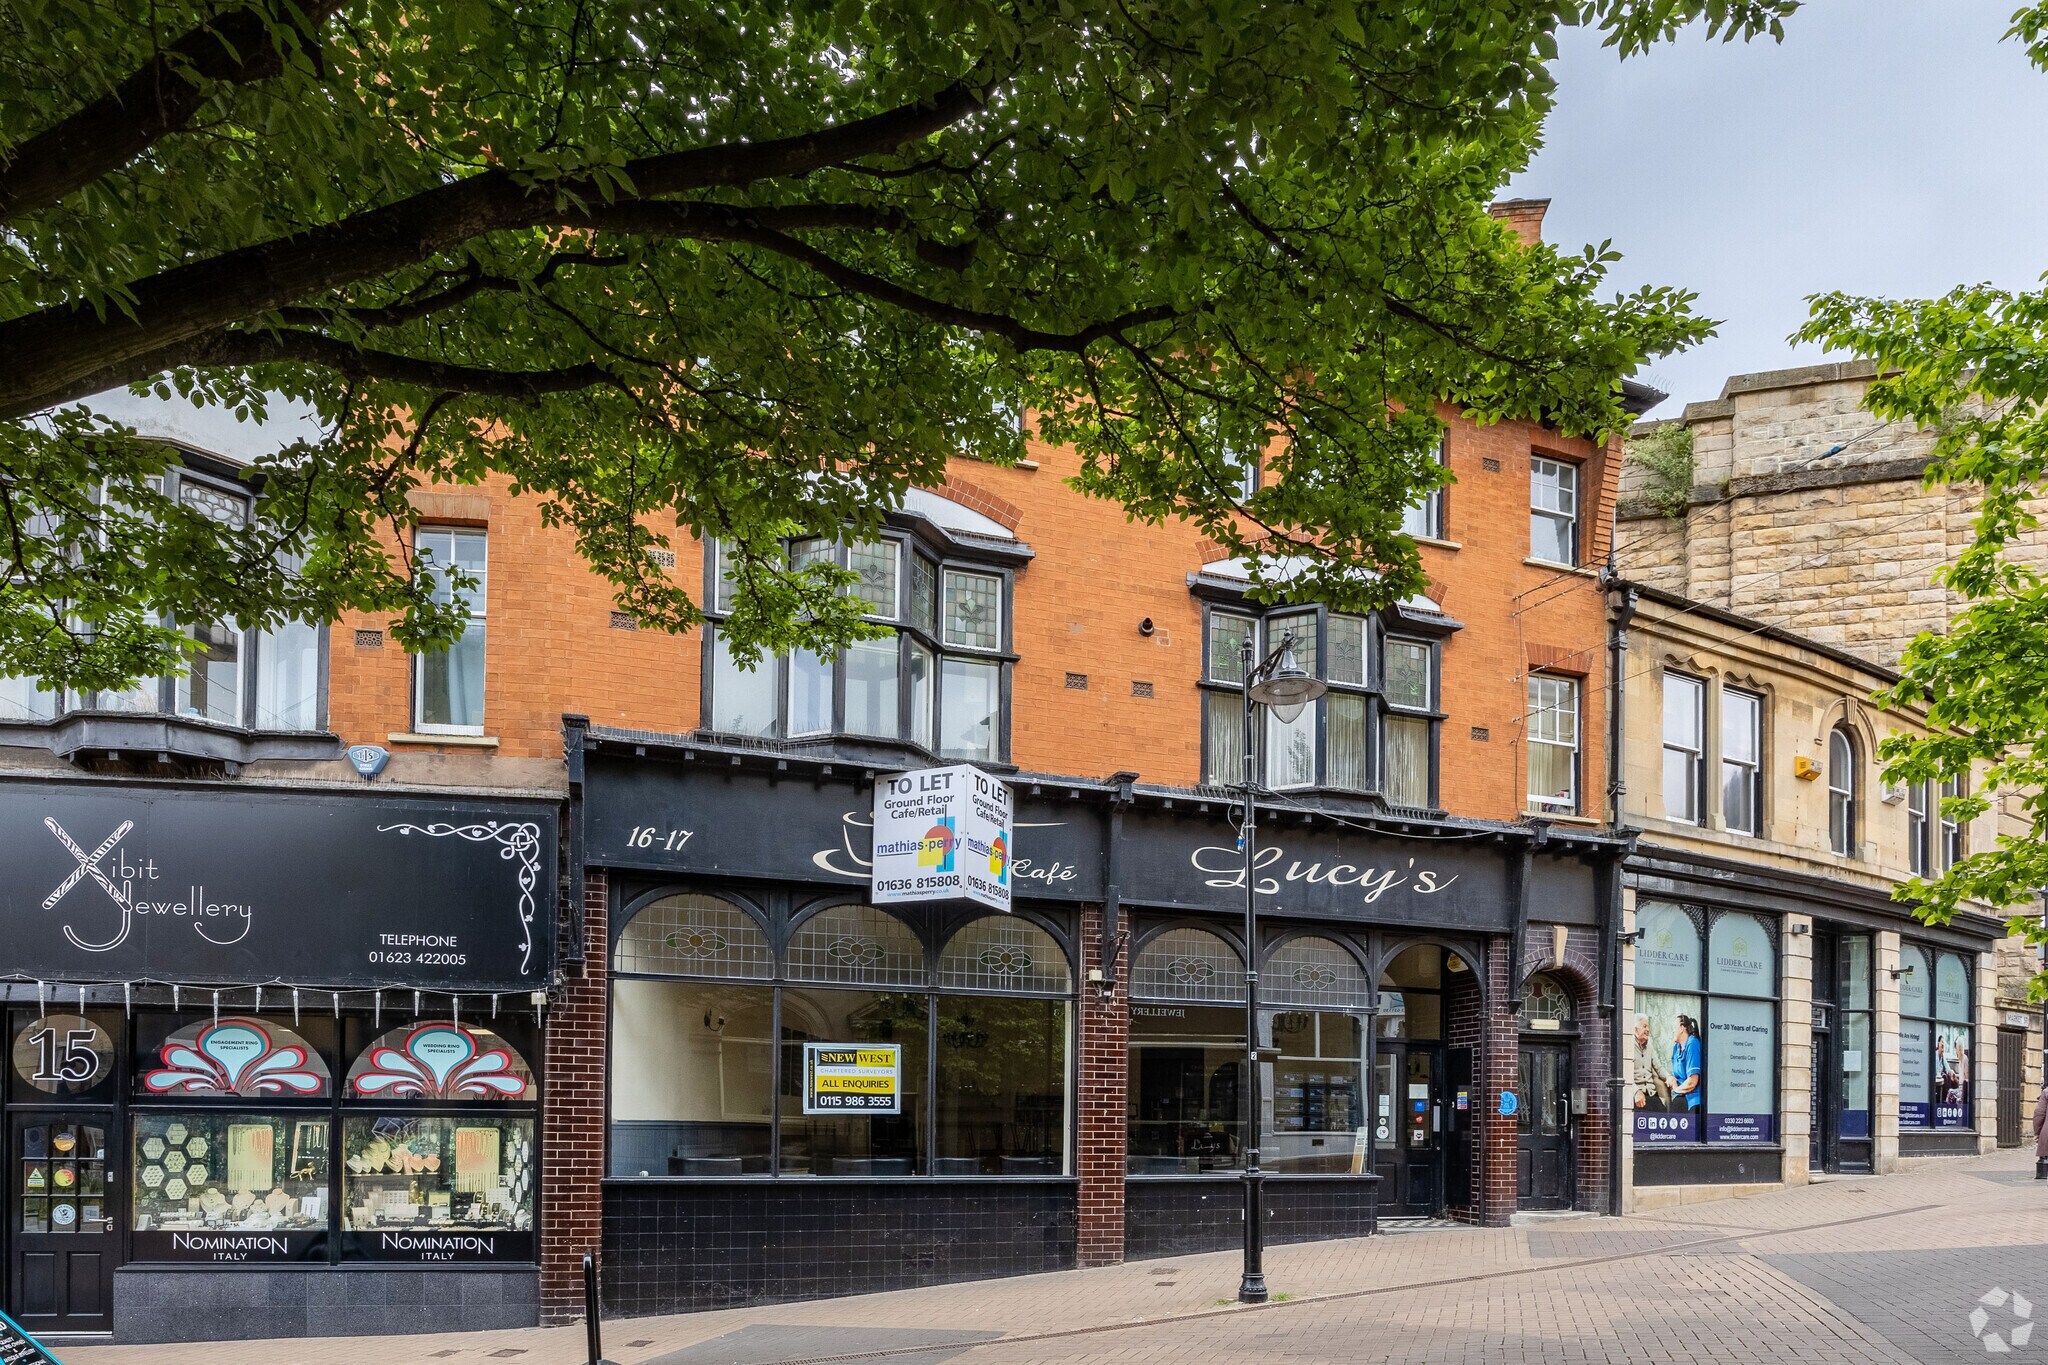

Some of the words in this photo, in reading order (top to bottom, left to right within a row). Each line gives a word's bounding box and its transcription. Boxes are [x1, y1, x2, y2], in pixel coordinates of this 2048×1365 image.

[888, 777, 913, 796] TO
[920, 773, 954, 793] LET
[974, 774, 989, 795] TO
[991, 783, 1009, 806] LET
[884, 796, 924, 810] Ground
[927, 794, 955, 806] Floor
[972, 794, 994, 814] Ground
[994, 804, 1008, 820] Floor
[891, 804, 947, 820] Cafe/Retail
[975, 808, 1005, 829] Cafe/Retail
[626, 825, 694, 852] 16-17
[42, 816, 160, 911] Xibit
[1010, 858, 1078, 886] Café
[877, 880, 912, 892] 01636
[916, 875, 960, 889] 815808
[1190, 846, 1459, 904] Lucy's
[886, 888, 950, 897] www.mathiasperry.co.uk
[967, 875, 988, 892] 01636
[987, 882, 1010, 900] 815808
[63, 880, 253, 952] Jewellery
[379, 933, 458, 948] TELEPHONE
[368, 951, 412, 964] 01623
[415, 952, 467, 966] 422005
[1710, 1022, 1723, 1031] Over
[1723, 1023, 1730, 1031] 30
[1731, 1024, 1745, 1032] Years
[1752, 1025, 1768, 1035] Caring
[29, 1027, 100, 1082] 15
[828, 1053, 856, 1063] NEW
[858, 1053, 891, 1063] WEST
[821, 1079, 840, 1088] ALL
[842, 1080, 890, 1089] ENQUIRIES
[820, 1095, 842, 1106] 0115
[844, 1096, 865, 1106] 986
[867, 1096, 892, 1106] 3555
[1649, 1133, 1677, 1141] @liddercare
[1719, 1125, 1760, 1134] info@liddercare.com
[173, 1232, 288, 1254] NOMINATION
[382, 1232, 494, 1254] NOMINATION
[213, 1252, 248, 1261] ITALY
[421, 1252, 455, 1260] ITALY
